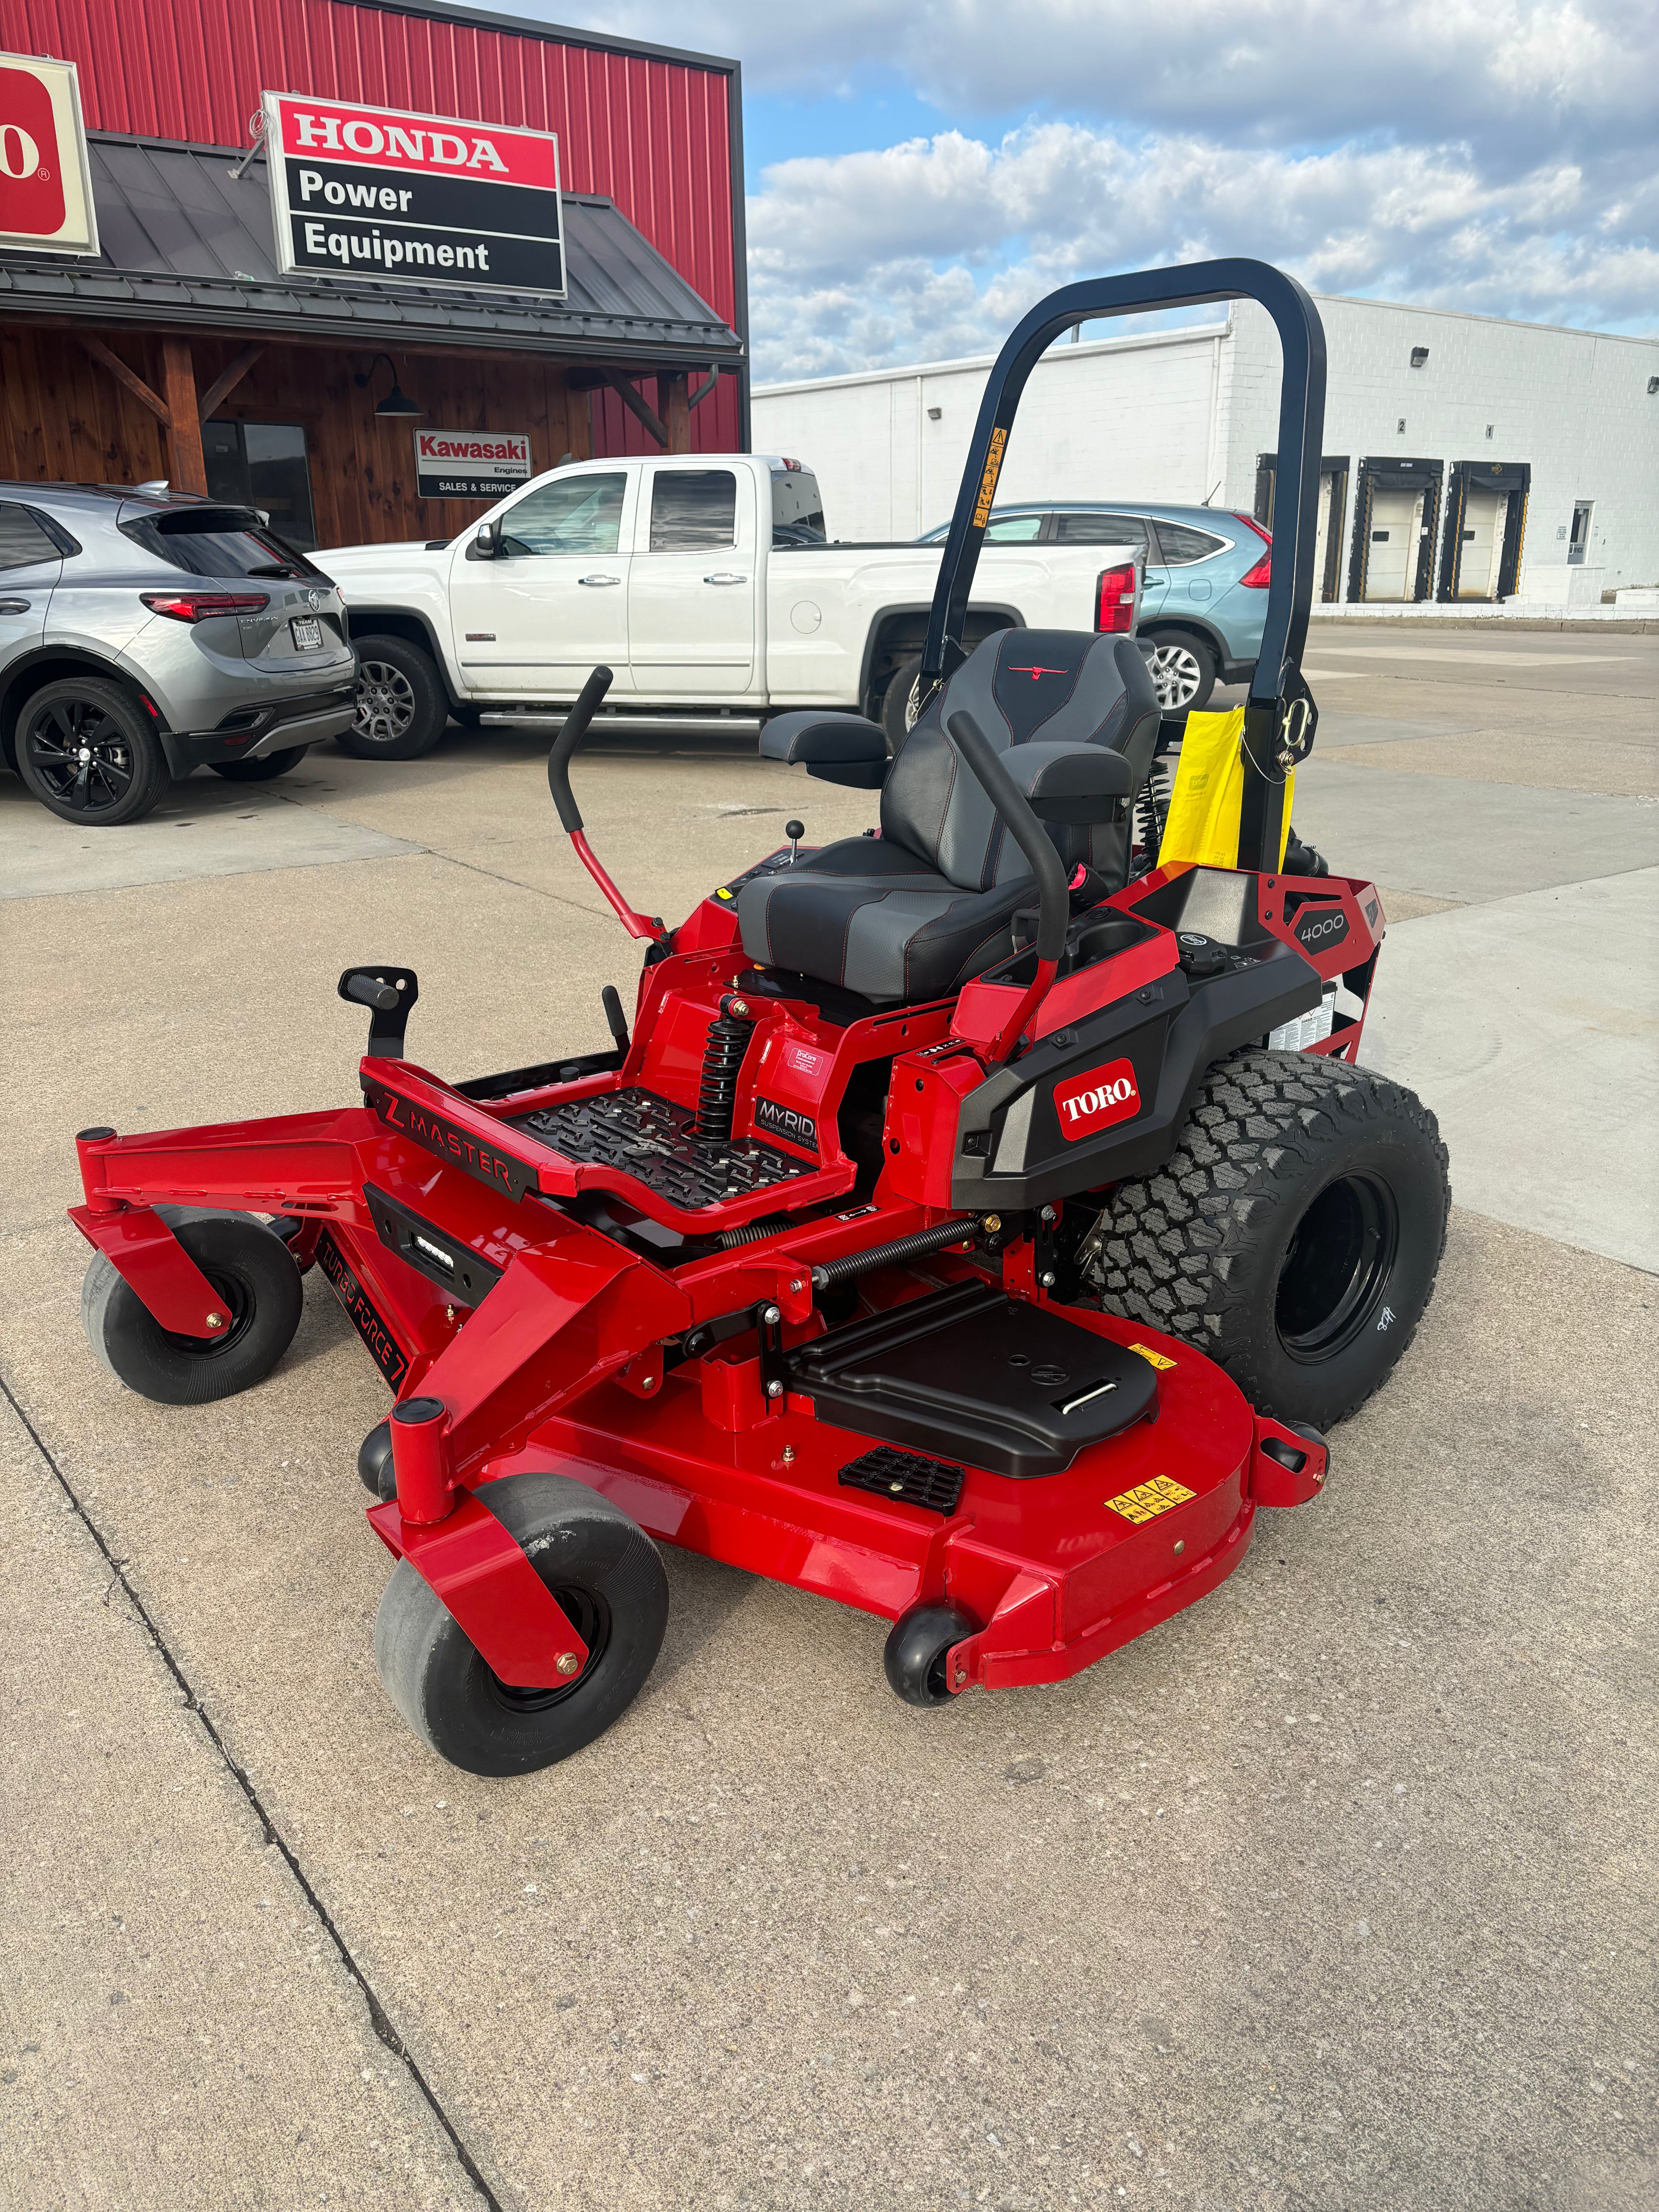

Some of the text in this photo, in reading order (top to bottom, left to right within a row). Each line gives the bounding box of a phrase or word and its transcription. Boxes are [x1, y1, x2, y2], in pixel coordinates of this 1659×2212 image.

[294, 113, 509, 172] HONDA
[299, 169, 412, 212] Power
[304, 222, 489, 271] Equipment
[1399, 421, 1405, 431] 2
[1488, 426, 1491, 436] 1
[420, 436, 526, 460] Kawasaki
[439, 482, 516, 493] SALES & SERVICE
[1301, 914, 1344, 941] 4000
[796, 1050, 816, 1061] ProCore
[1062, 1078, 1132, 1121] TORO
[385, 1092, 513, 1193] Z MASTER
[761, 1119, 796, 1139] SUSPENSION
[324, 1242, 404, 1381] TURBO FORCE 7
